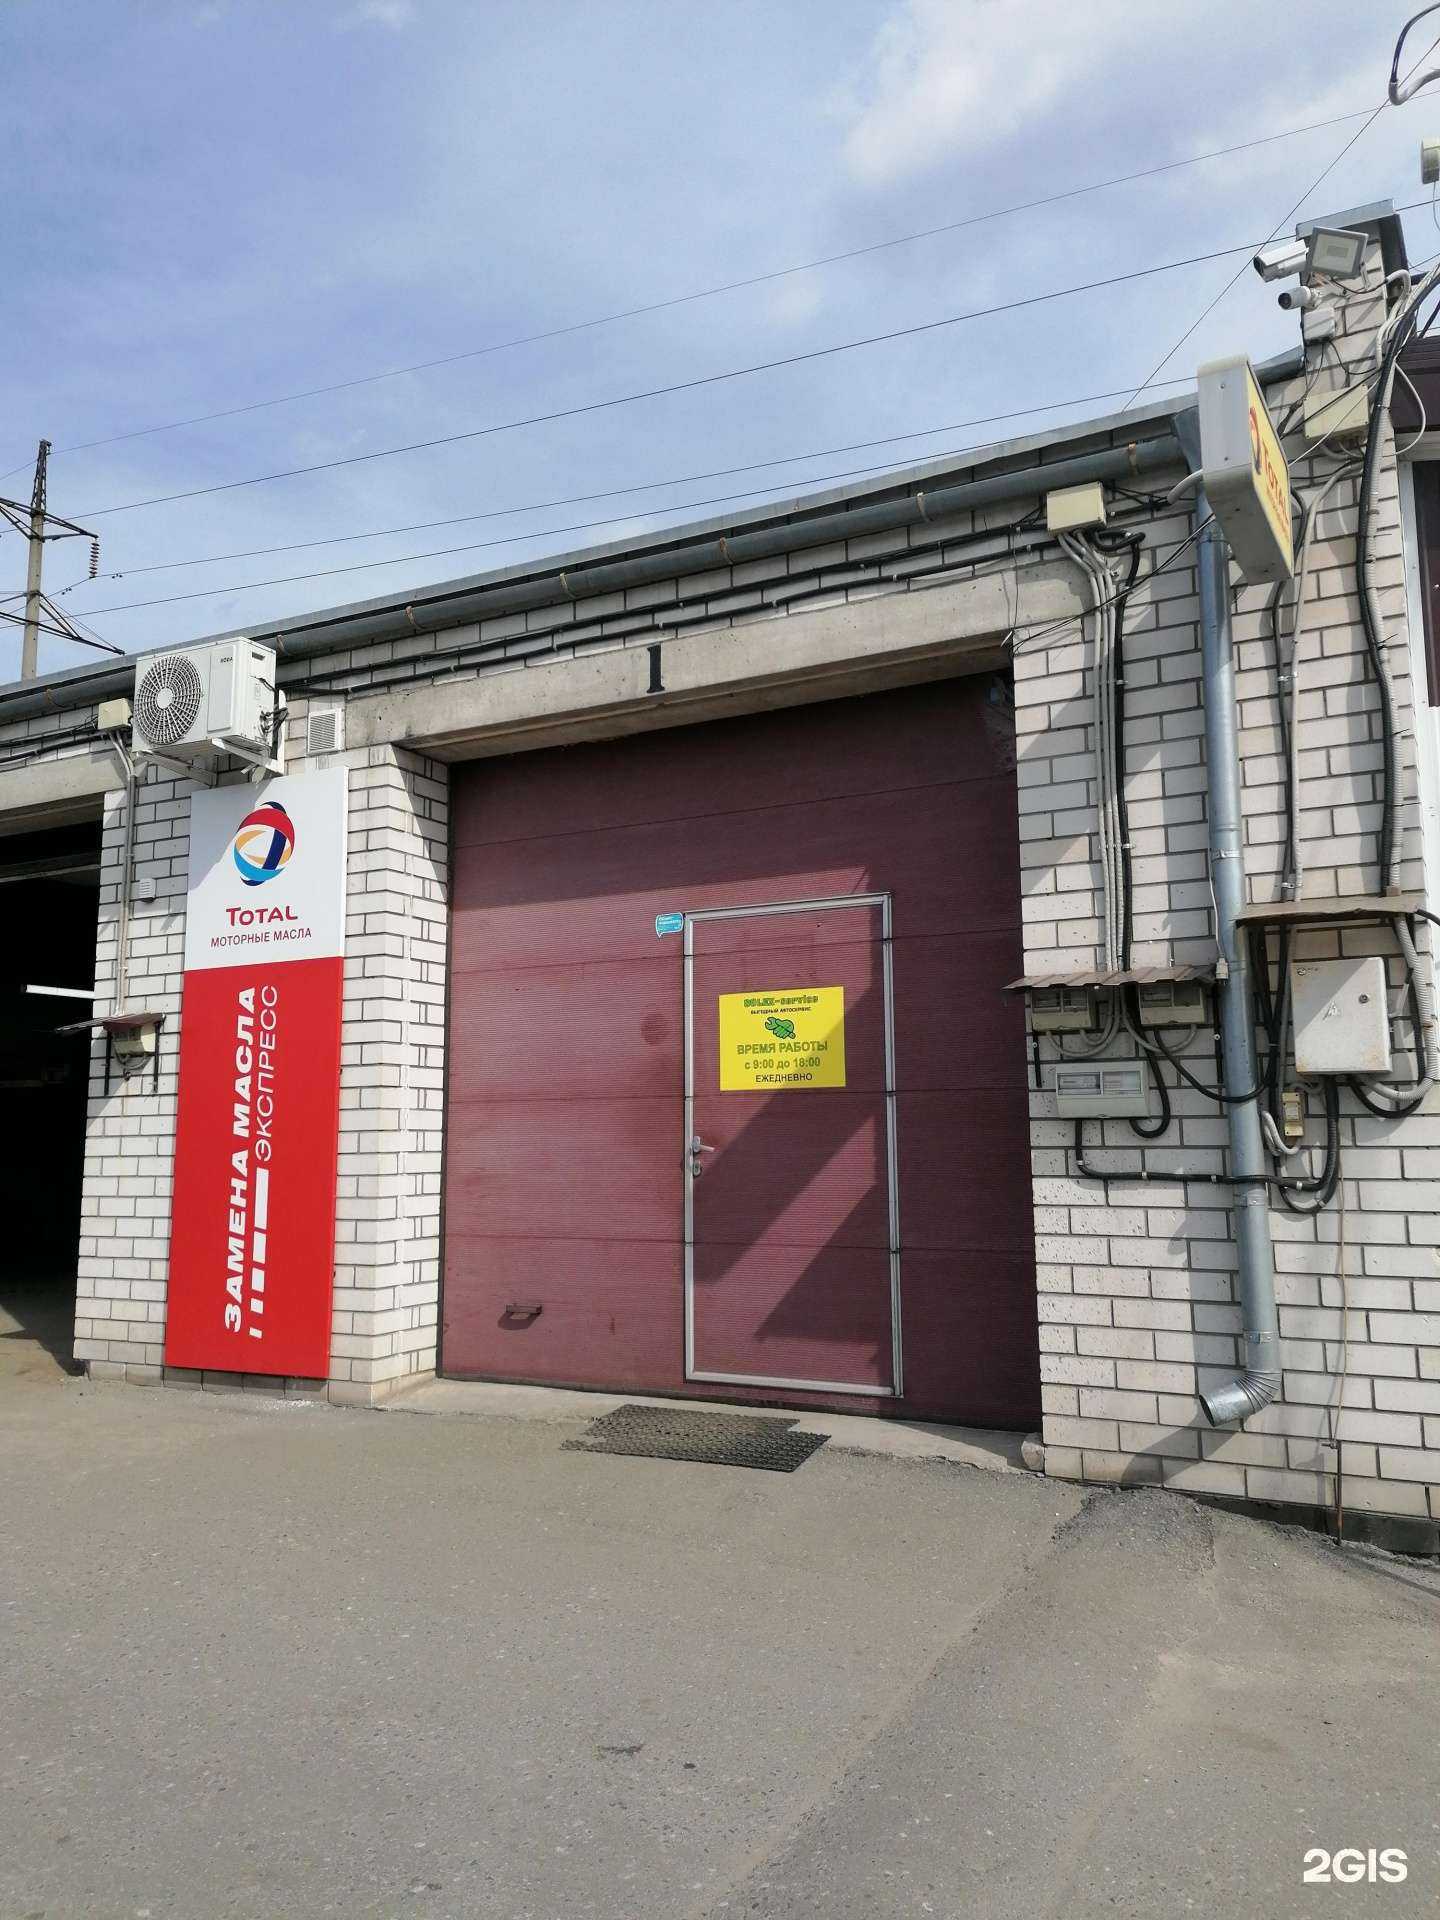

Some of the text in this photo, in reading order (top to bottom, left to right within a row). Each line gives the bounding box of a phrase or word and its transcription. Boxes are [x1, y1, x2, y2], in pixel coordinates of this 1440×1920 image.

[211, 927, 312, 948] МОТОРНЫЕ МАСЛА
[737, 1040, 828, 1055] ВРЕМЯ РАБОТЫ
[744, 1056, 821, 1070] с 9:00 до 18:00
[255, 984, 278, 1162] ЭКСПРЕСС
[755, 1073, 813, 1083] ЕЖЕДНЕВНО
[224, 986, 256, 1334] ЗАМЕНА МАСЛА
